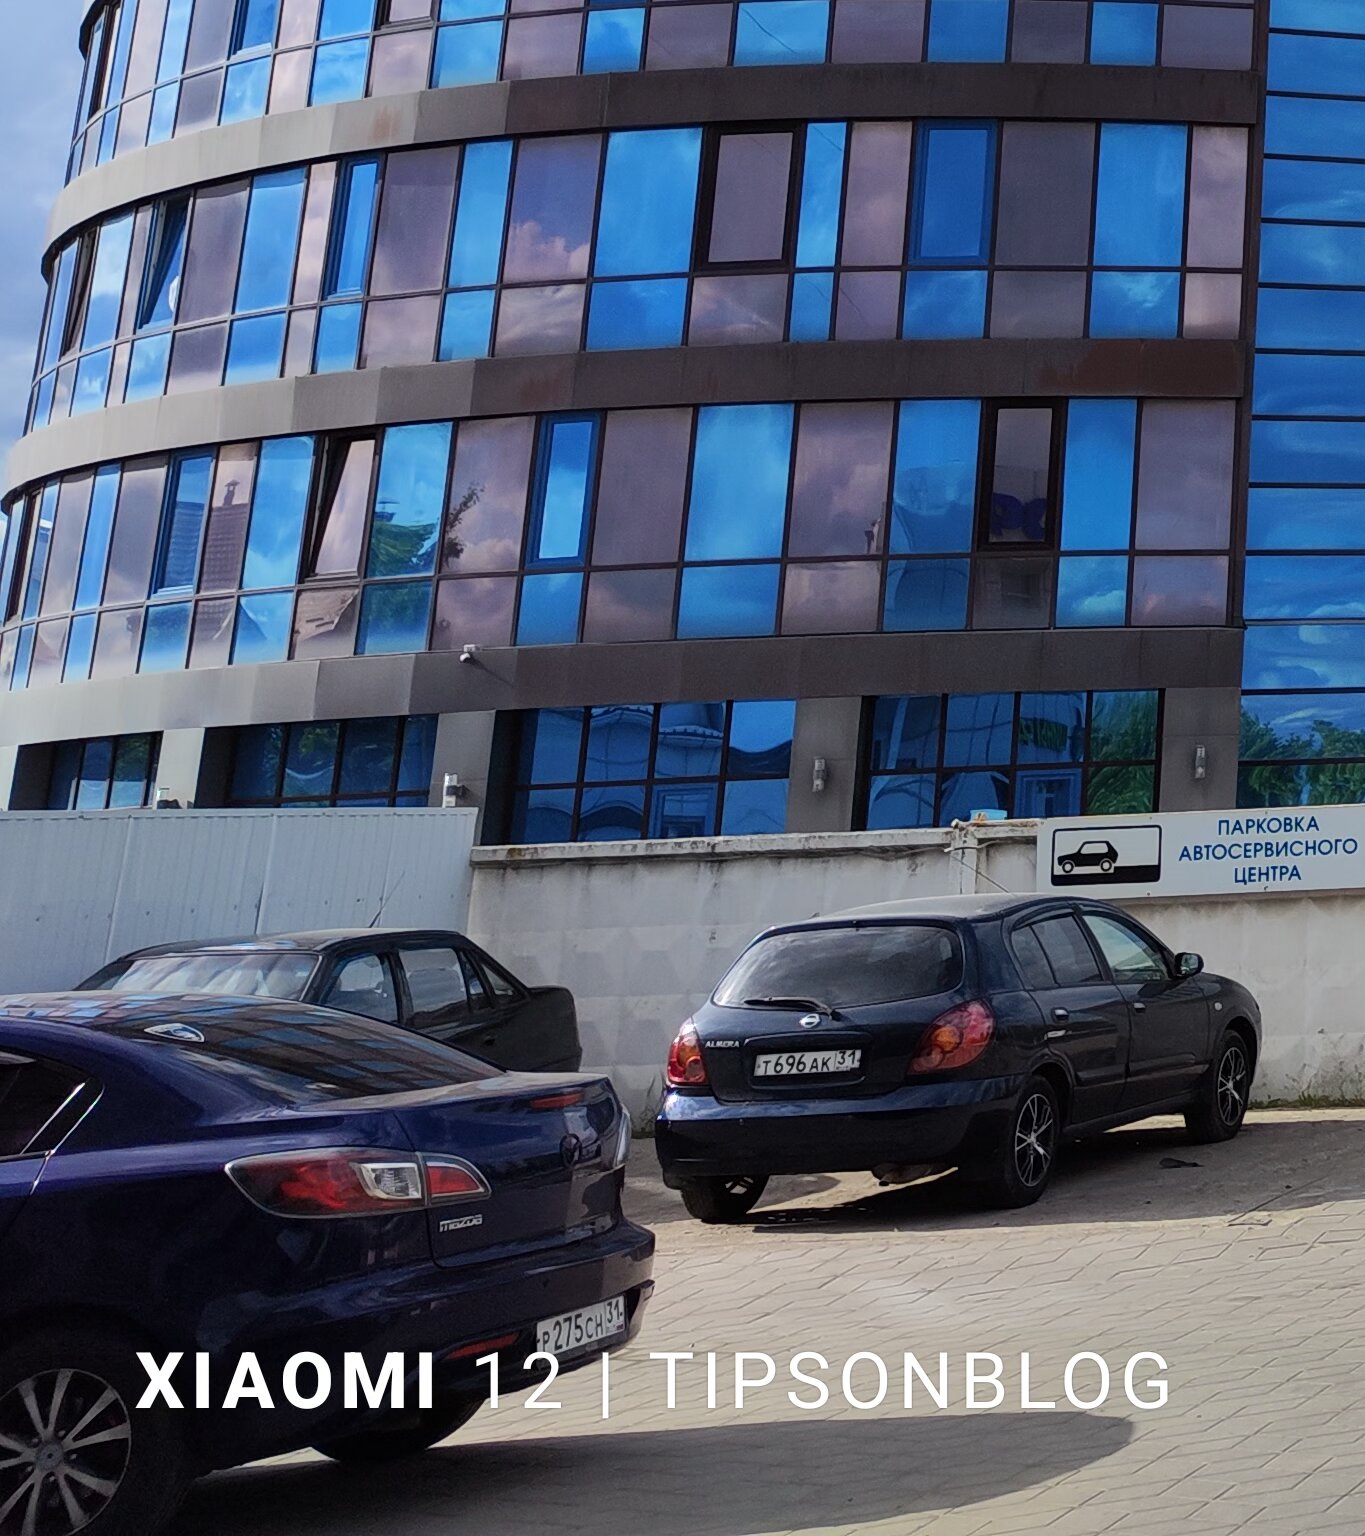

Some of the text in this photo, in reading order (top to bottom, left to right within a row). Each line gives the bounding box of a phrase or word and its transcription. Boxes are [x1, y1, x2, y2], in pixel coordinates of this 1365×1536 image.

[1218, 815, 1320, 836] ПАРКОВКА
[1178, 838, 1359, 862] АВТОСЕРВИСНОГО
[1233, 865, 1302, 885] ЦЕНТРА
[704, 1040, 740, 1049] ALMERA
